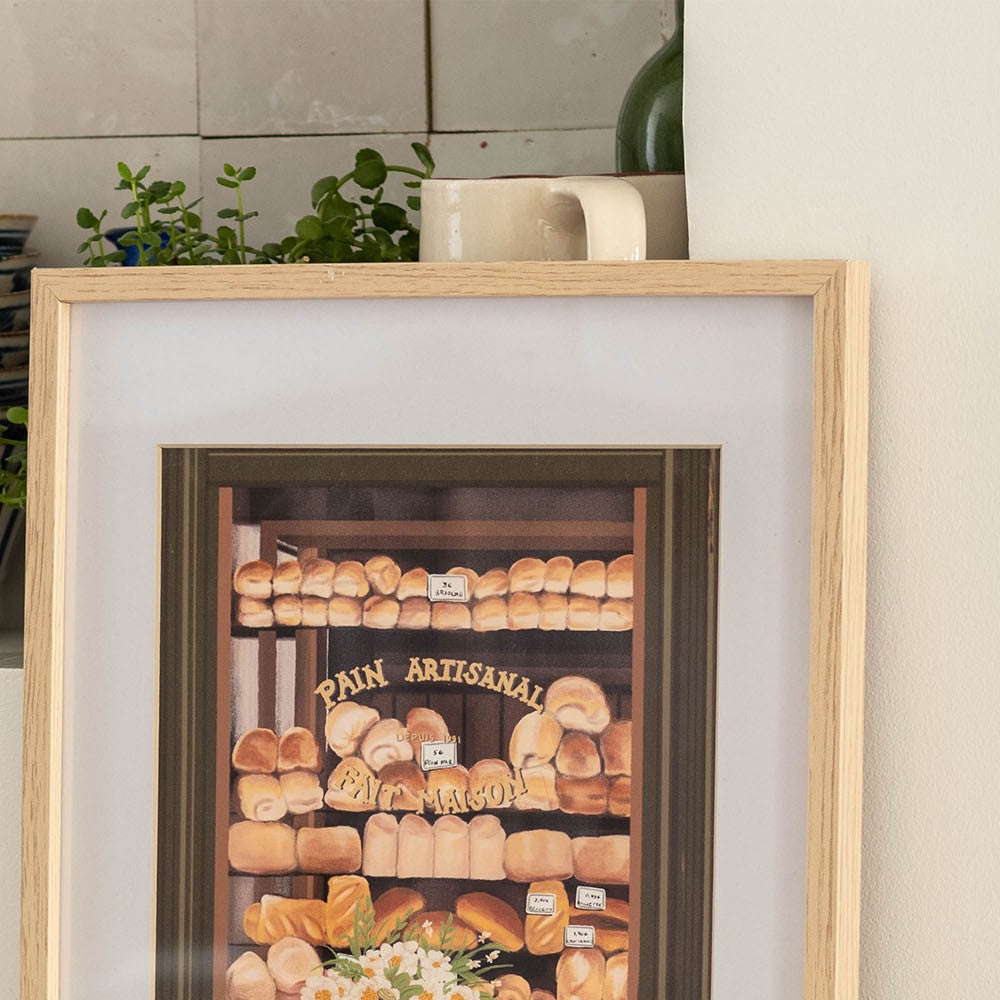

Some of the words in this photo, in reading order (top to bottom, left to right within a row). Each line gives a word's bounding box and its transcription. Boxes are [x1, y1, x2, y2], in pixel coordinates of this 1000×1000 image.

[314, 658, 389, 710] PAIN
[404, 656, 544, 714] ARTISANAL
[396, 733, 434, 743] DEPUIS
[334, 766, 402, 811] FAIT
[416, 767, 529, 815] MAISON
